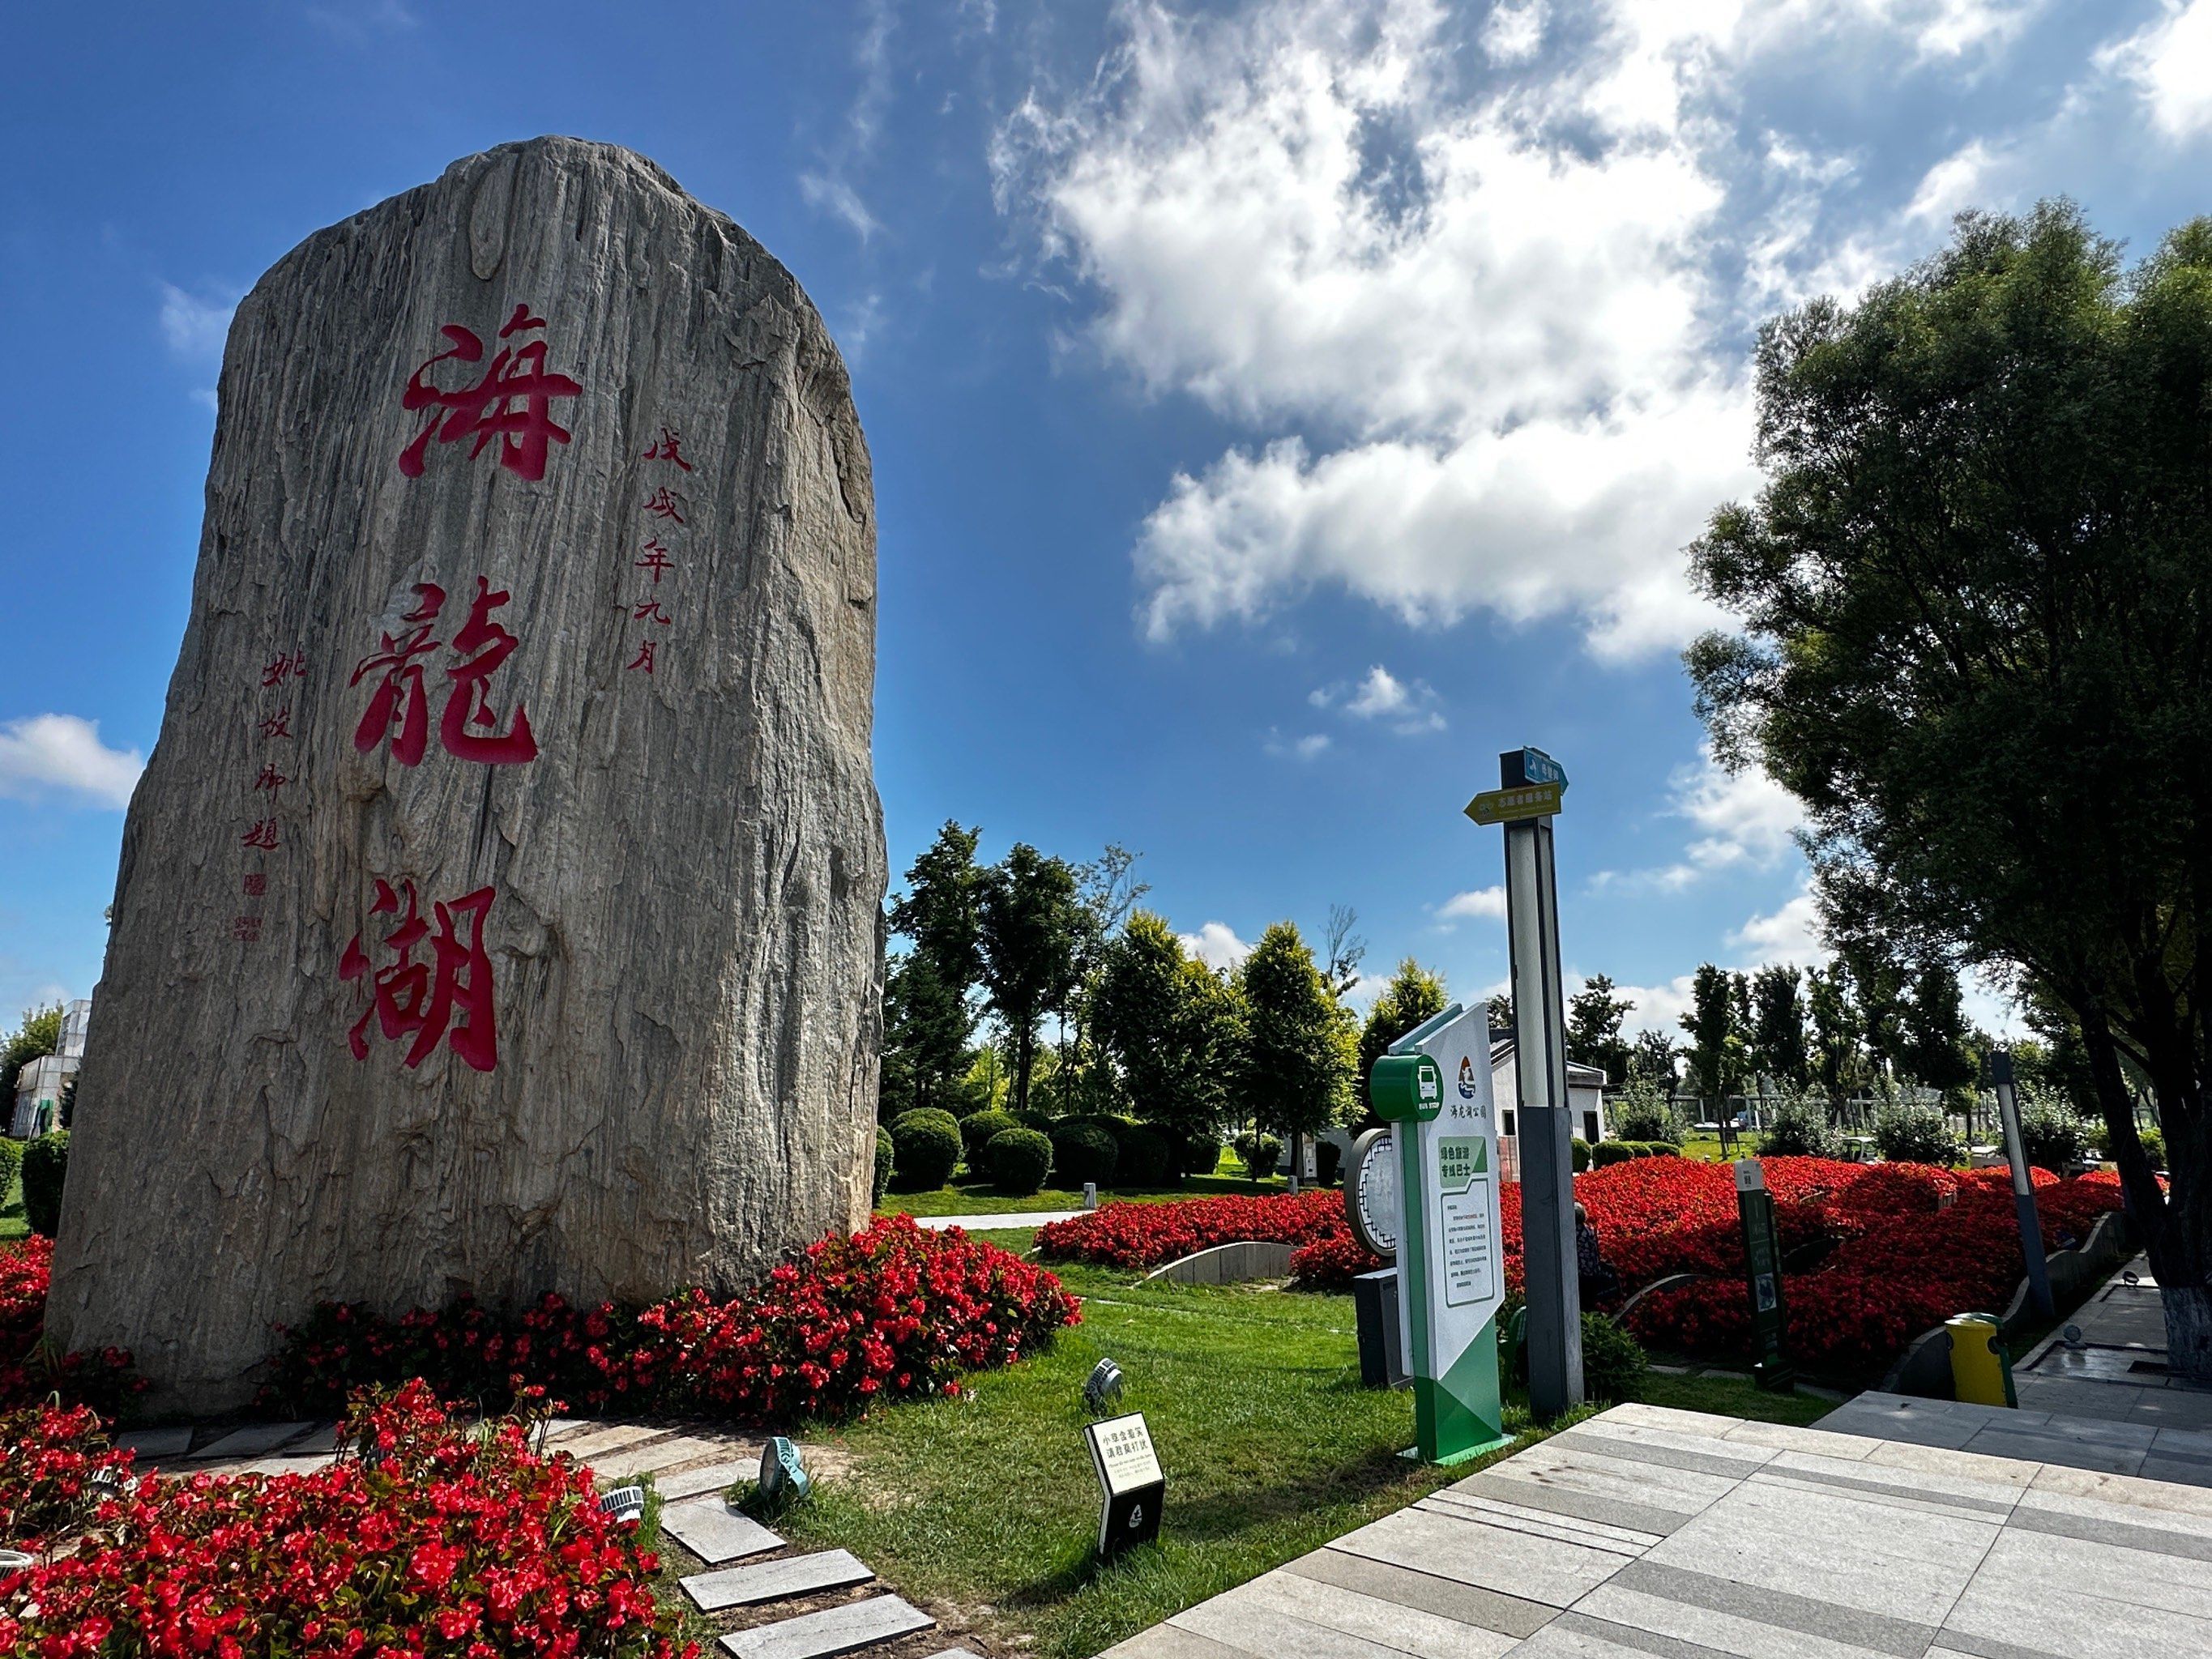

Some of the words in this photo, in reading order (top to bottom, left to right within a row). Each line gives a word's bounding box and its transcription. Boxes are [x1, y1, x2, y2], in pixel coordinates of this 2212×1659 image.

[1497, 790, 1552, 808] 志愿者服务站
[1441, 1146, 1469, 1160] 绿色旅游
[1441, 1163, 1471, 1178] 专线巴士
